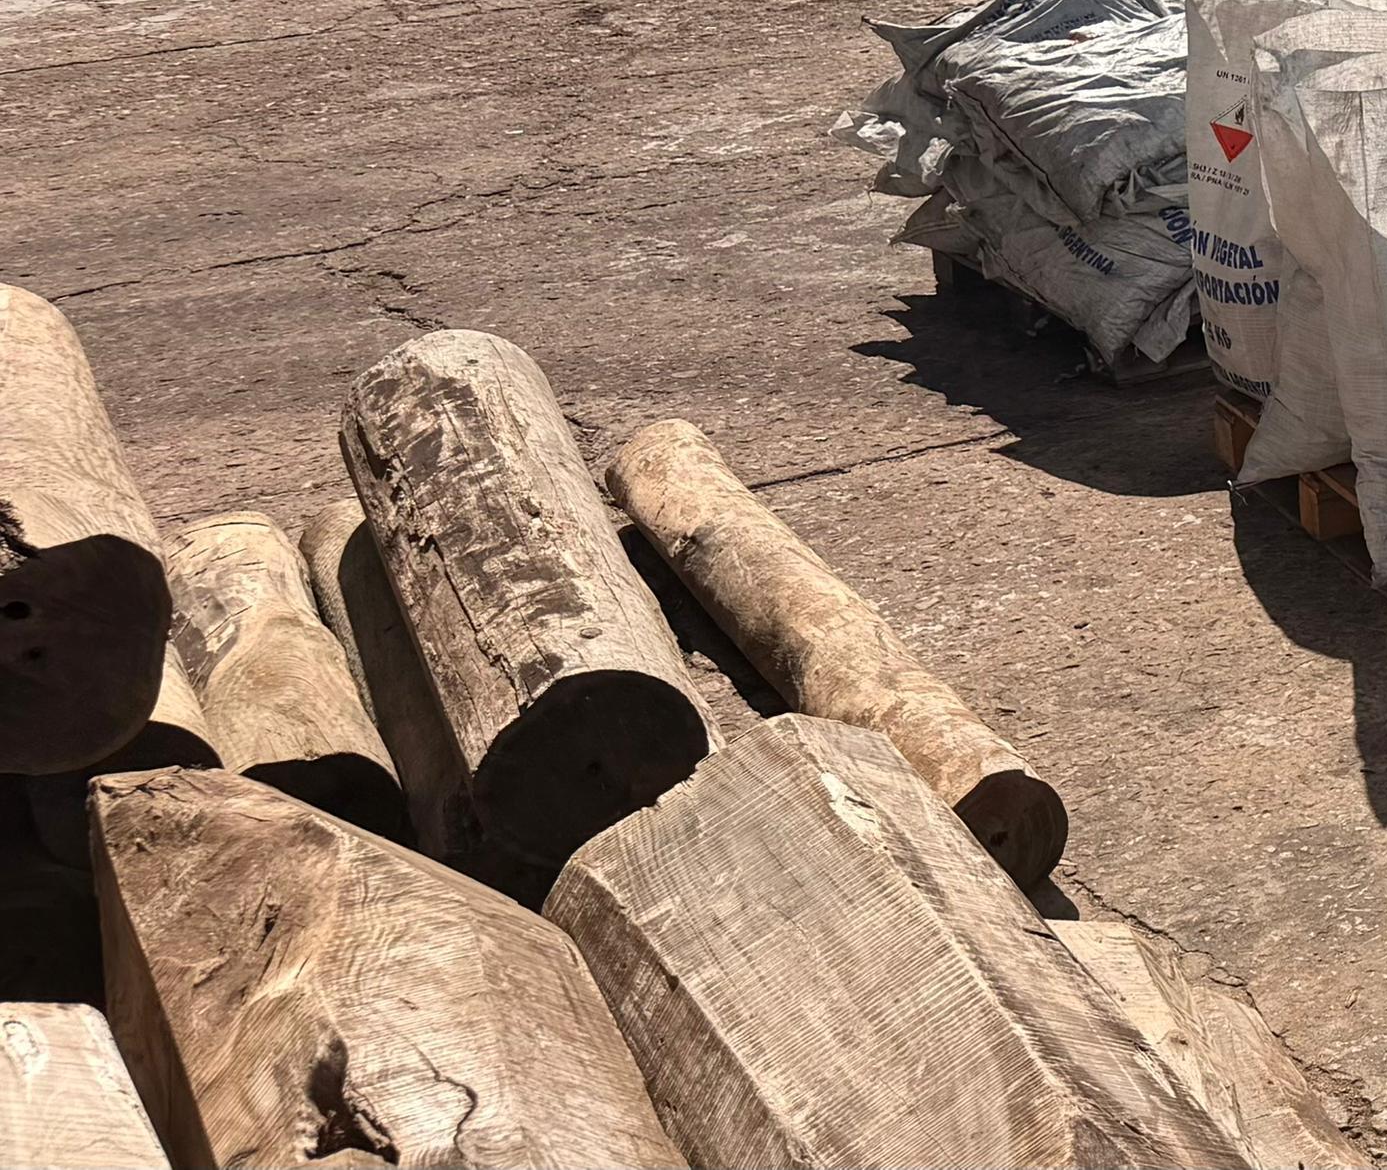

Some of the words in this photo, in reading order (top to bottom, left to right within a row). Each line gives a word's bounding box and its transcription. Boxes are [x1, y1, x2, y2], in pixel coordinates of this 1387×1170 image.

[1216, 70, 1229, 80] UN
[1057, 225, 1115, 276] RGENTINA
[1210, 234, 1264, 269] VEGETAL
[1215, 324, 1232, 350] KG
